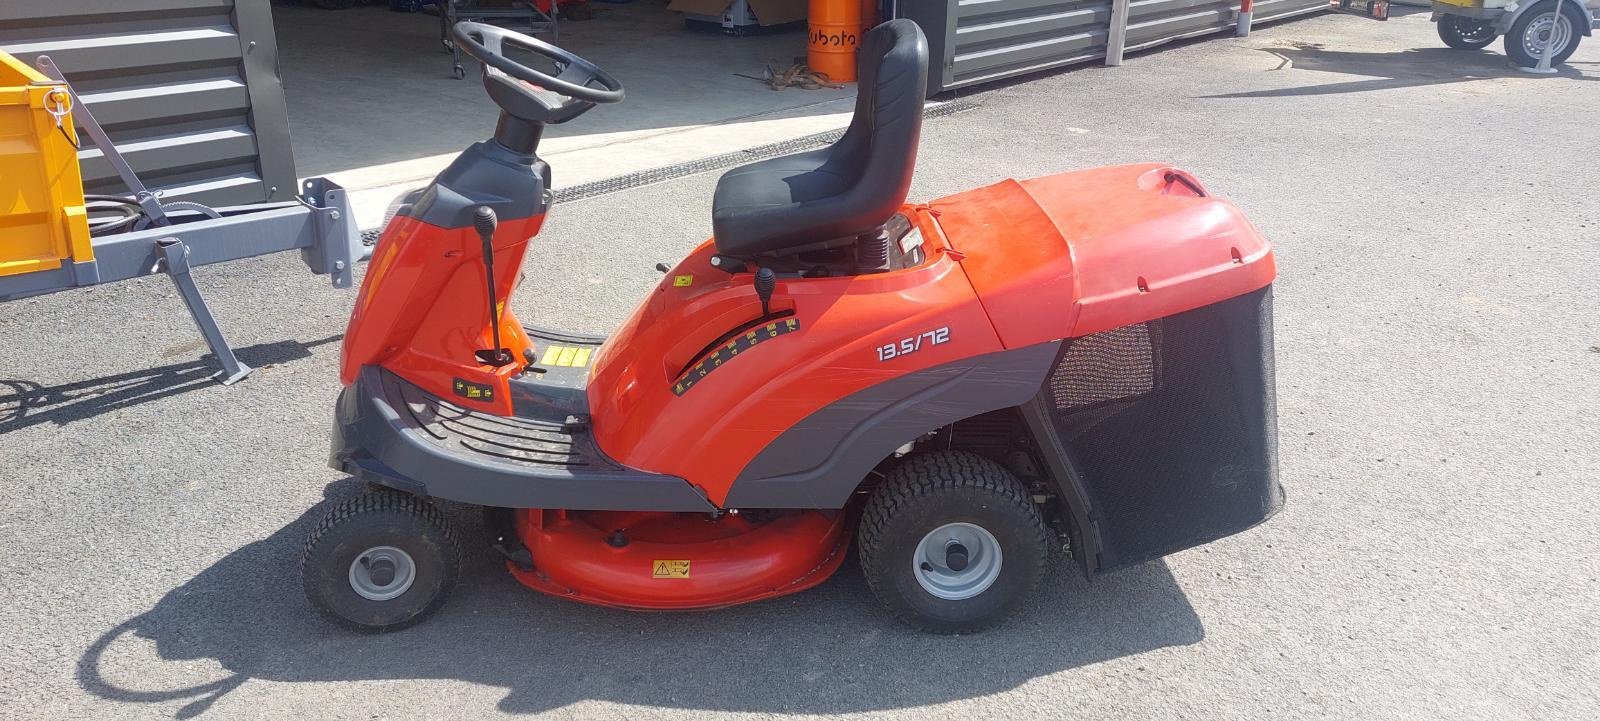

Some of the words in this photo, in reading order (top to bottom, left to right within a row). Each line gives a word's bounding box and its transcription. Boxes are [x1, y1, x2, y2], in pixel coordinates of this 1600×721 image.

[699, 368, 707, 377] 2
[714, 358, 722, 367] 3
[731, 348, 738, 356] 4
[769, 330, 777, 338] 6
[876, 326, 950, 362] 13.5/72
